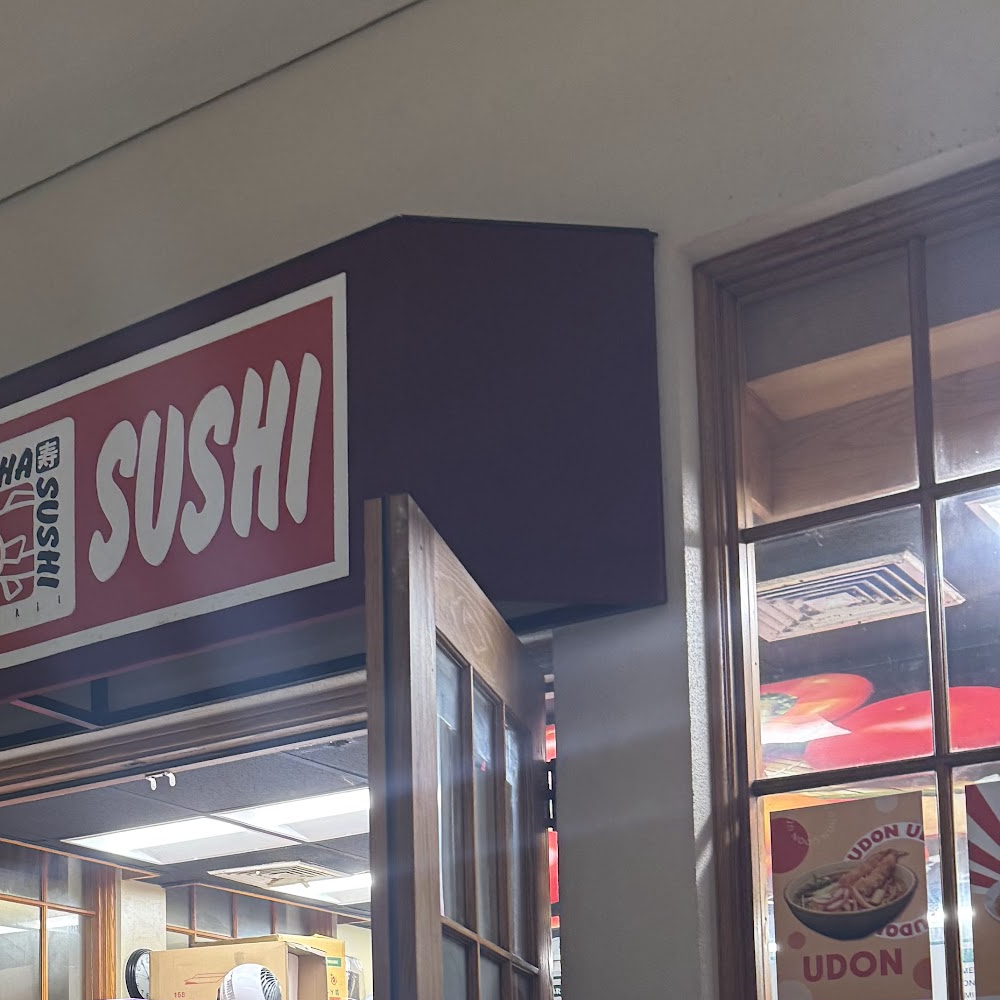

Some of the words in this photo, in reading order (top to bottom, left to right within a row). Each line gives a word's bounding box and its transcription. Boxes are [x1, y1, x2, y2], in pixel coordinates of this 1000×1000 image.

[37, 440, 58, 471] 寿
[89, 352, 321, 582] SUSHI
[36, 476, 60, 588] SUSHI
[847, 824, 899, 860] UDON
[876, 918, 928, 937] UDO
[803, 948, 903, 983] UDON
